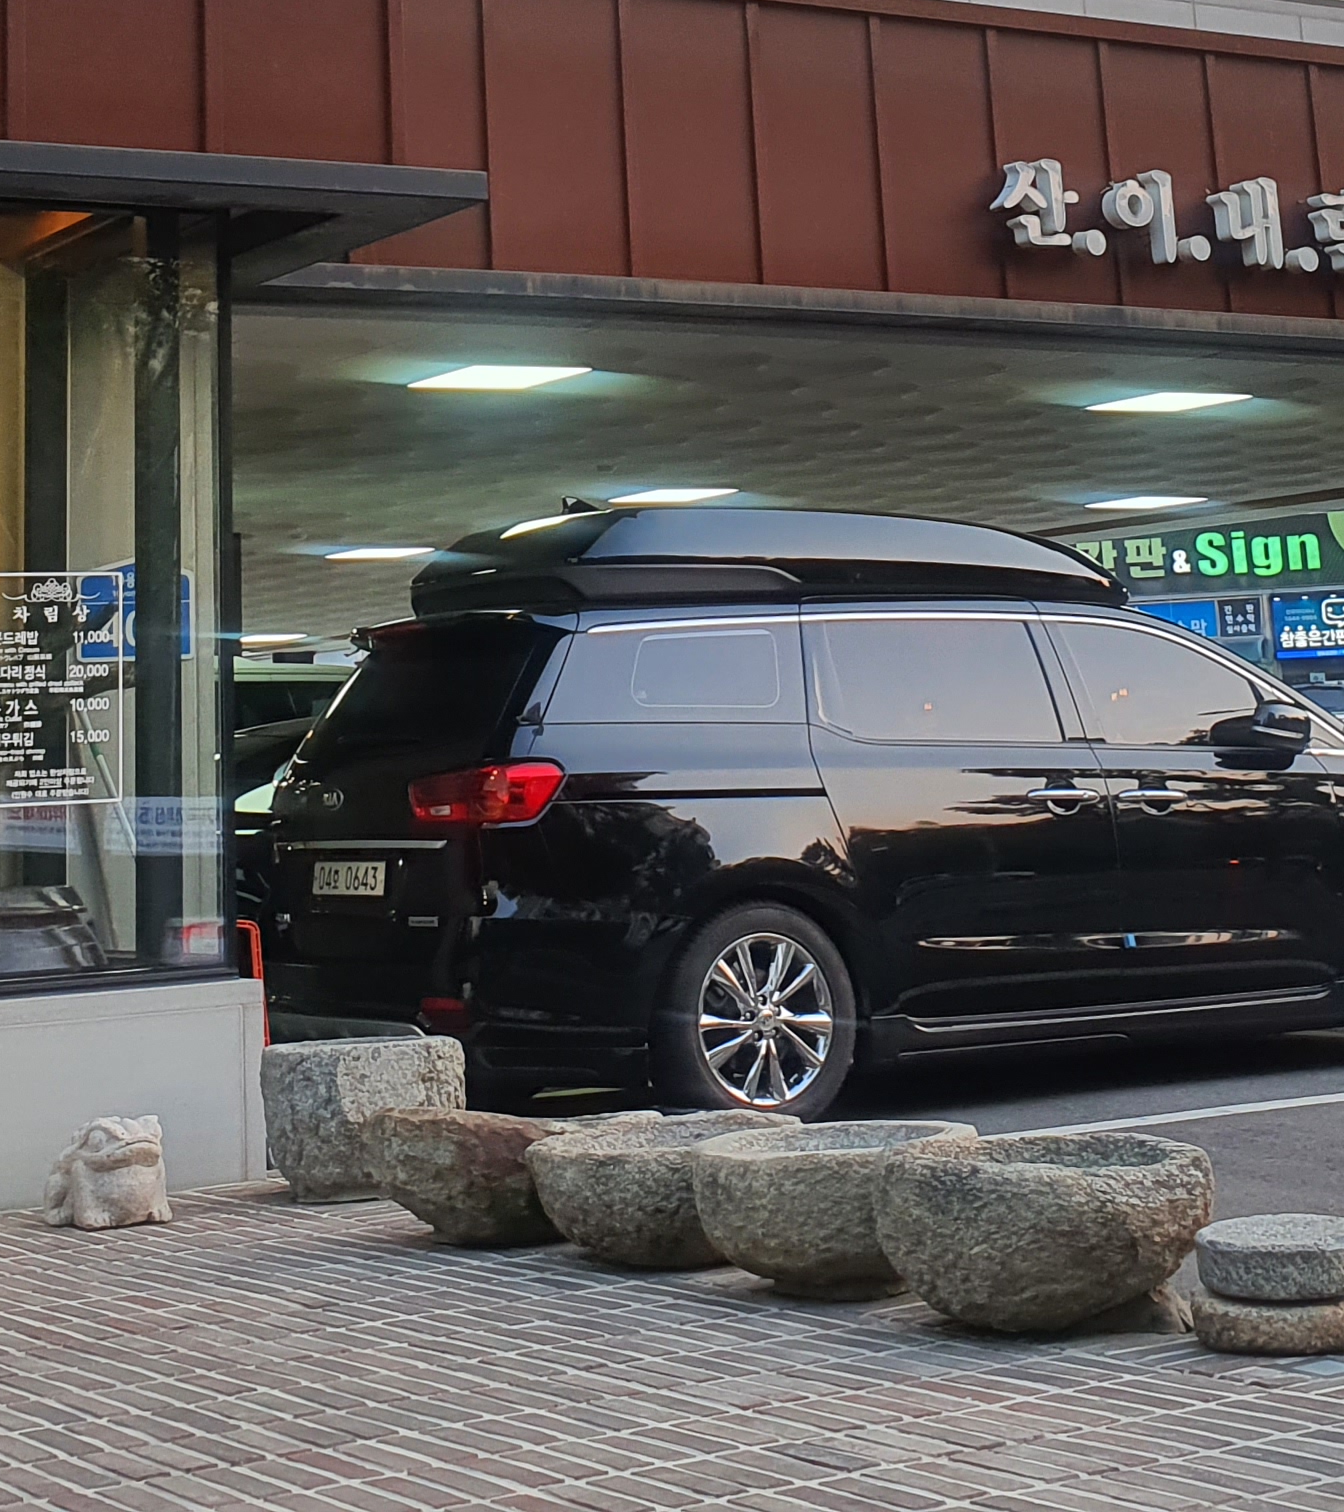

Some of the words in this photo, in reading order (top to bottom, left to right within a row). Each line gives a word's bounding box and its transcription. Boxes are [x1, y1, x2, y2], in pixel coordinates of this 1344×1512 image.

[72, 631, 109, 645] 11,000
[69, 664, 109, 679] 20,000
[70, 698, 110, 712] 10,000
[70, 730, 110, 744] 15,000
[345, 866, 378, 891] 0643
